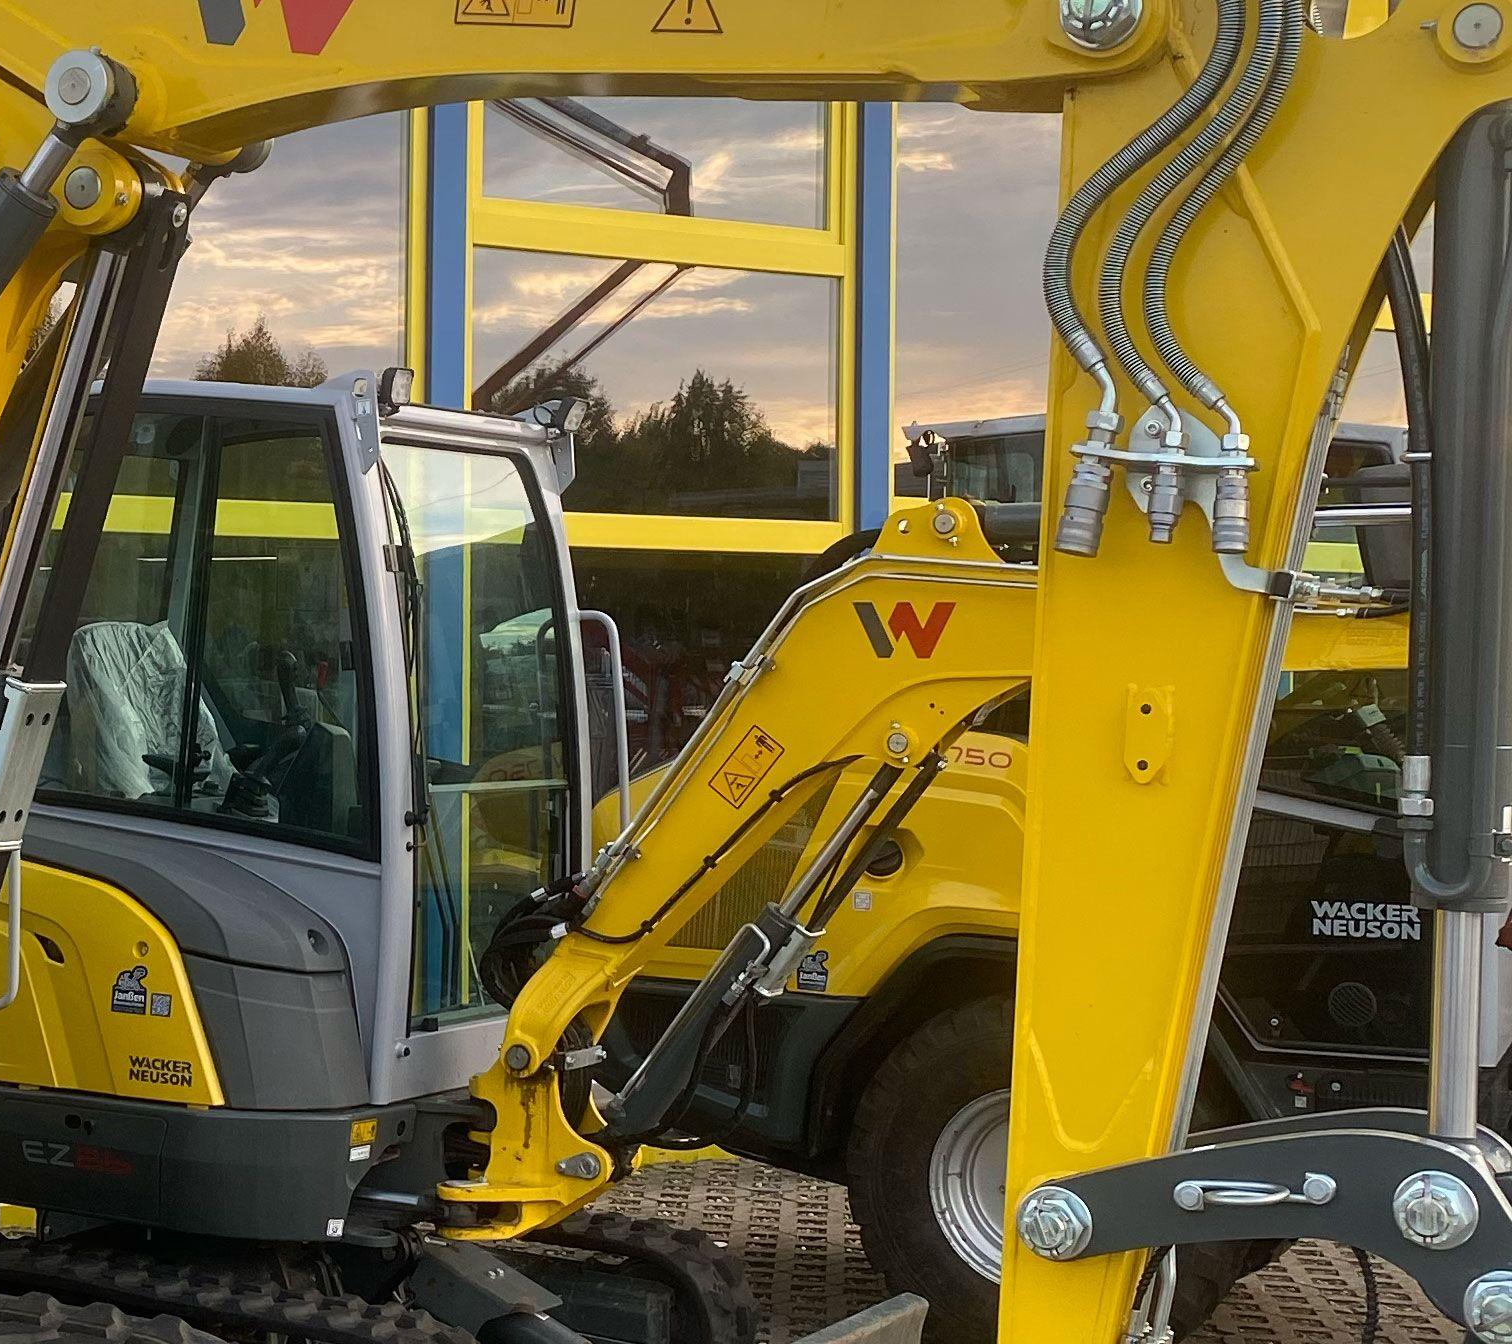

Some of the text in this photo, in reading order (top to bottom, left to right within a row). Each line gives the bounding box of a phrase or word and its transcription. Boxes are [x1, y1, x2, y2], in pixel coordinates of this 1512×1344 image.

[1310, 899, 1421, 923] WACKER
[1312, 918, 1421, 941] NEUSON
[129, 1055, 193, 1075] WACKER
[129, 1068, 193, 1088] NEUSON
